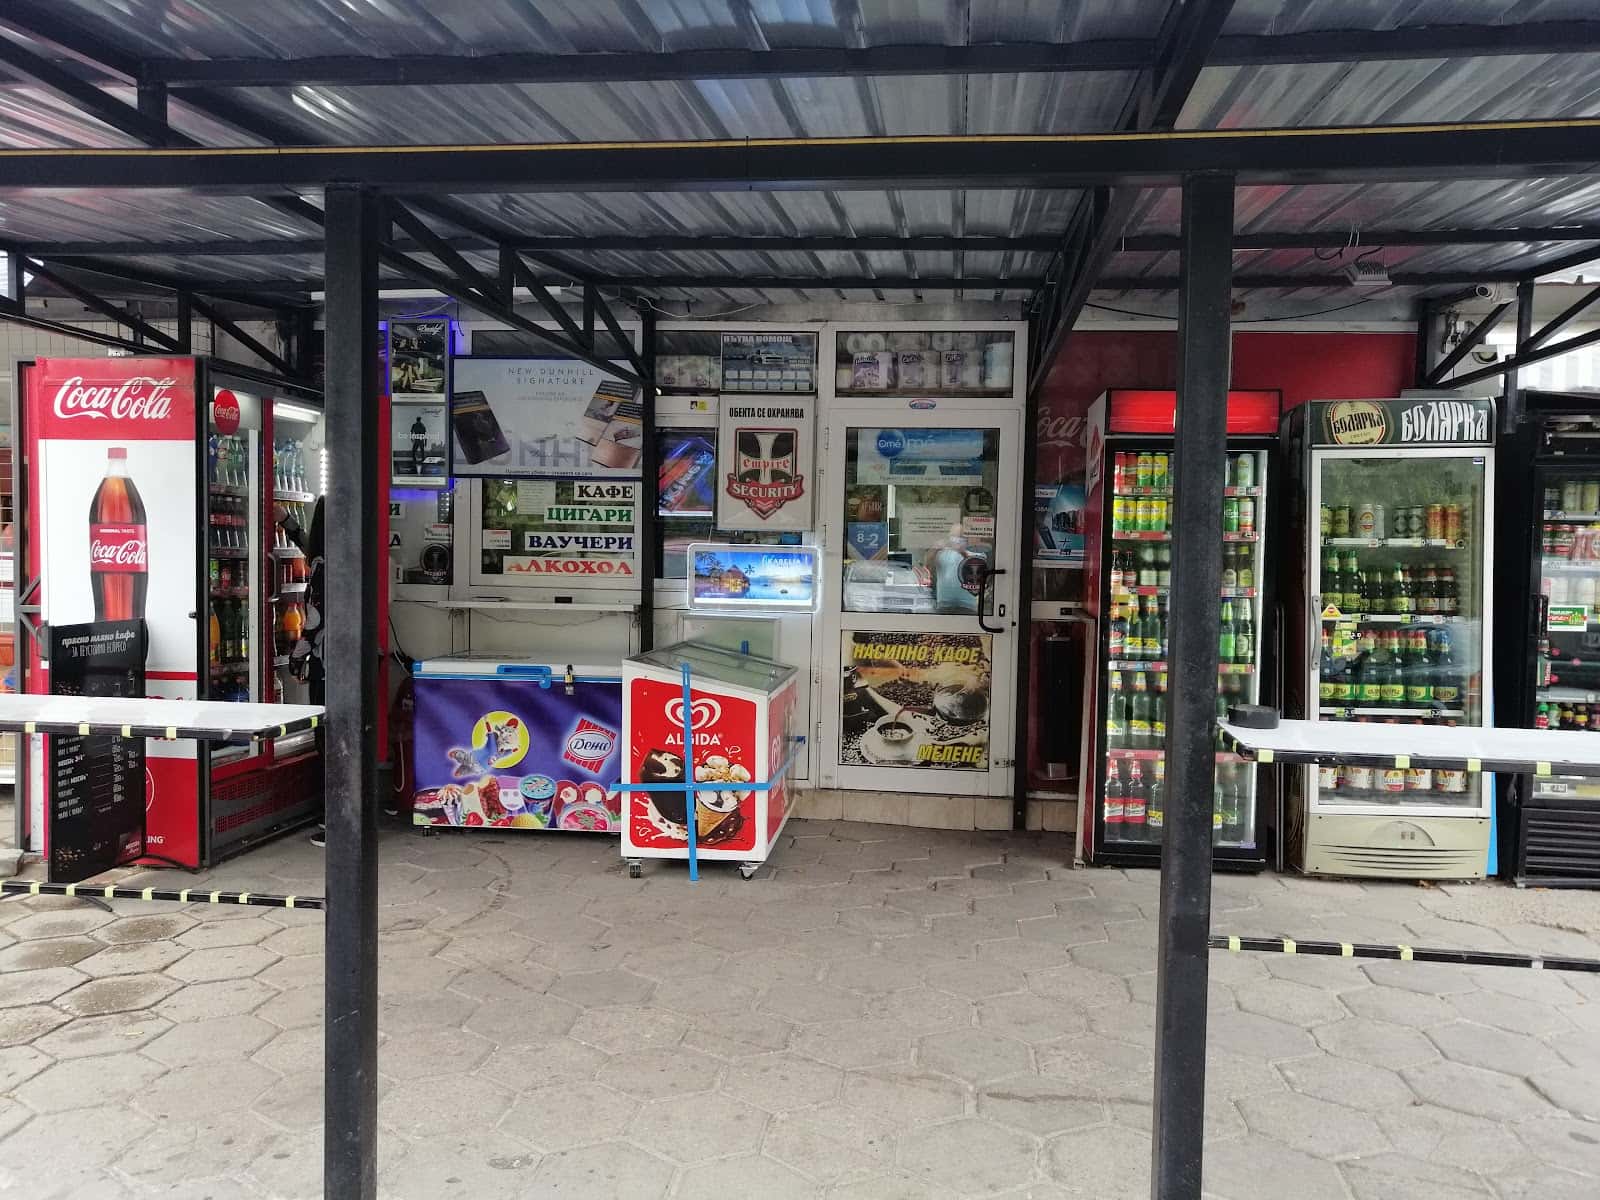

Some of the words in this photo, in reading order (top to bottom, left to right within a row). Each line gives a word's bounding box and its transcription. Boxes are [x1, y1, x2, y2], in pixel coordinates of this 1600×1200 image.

[723, 335, 754, 345] ПЪТНА
[755, 335, 793, 344] ПОМОЩ
[508, 367, 533, 375] NEW
[539, 367, 593, 376] DUNHILL
[516, 376, 585, 385] SIGNATURE
[53, 376, 176, 420] Coca-Cola
[729, 407, 755, 418] ОБЕКТА
[756, 407, 766, 418] СЕ
[767, 407, 804, 419] ОХРАНЯВА
[1333, 411, 1385, 434] БОЛЯРКА
[1401, 401, 1488, 441] БОЛЯРКА
[743, 458, 790, 471] empire
[577, 485, 633, 499] КАФЕ
[732, 483, 797, 498] SECURITY
[546, 507, 633, 522] ЦИГАРИ
[528, 534, 633, 550] ВАУЧЕРИ
[90, 539, 146, 565] Coca-Cola
[507, 559, 633, 576] АЛКОХОЛ
[853, 643, 928, 661] НАСИПНО
[933, 647, 980, 664] КАФЕ
[917, 744, 984, 763] МЕЛЕНЕ
[146, 835, 164, 844] ING
